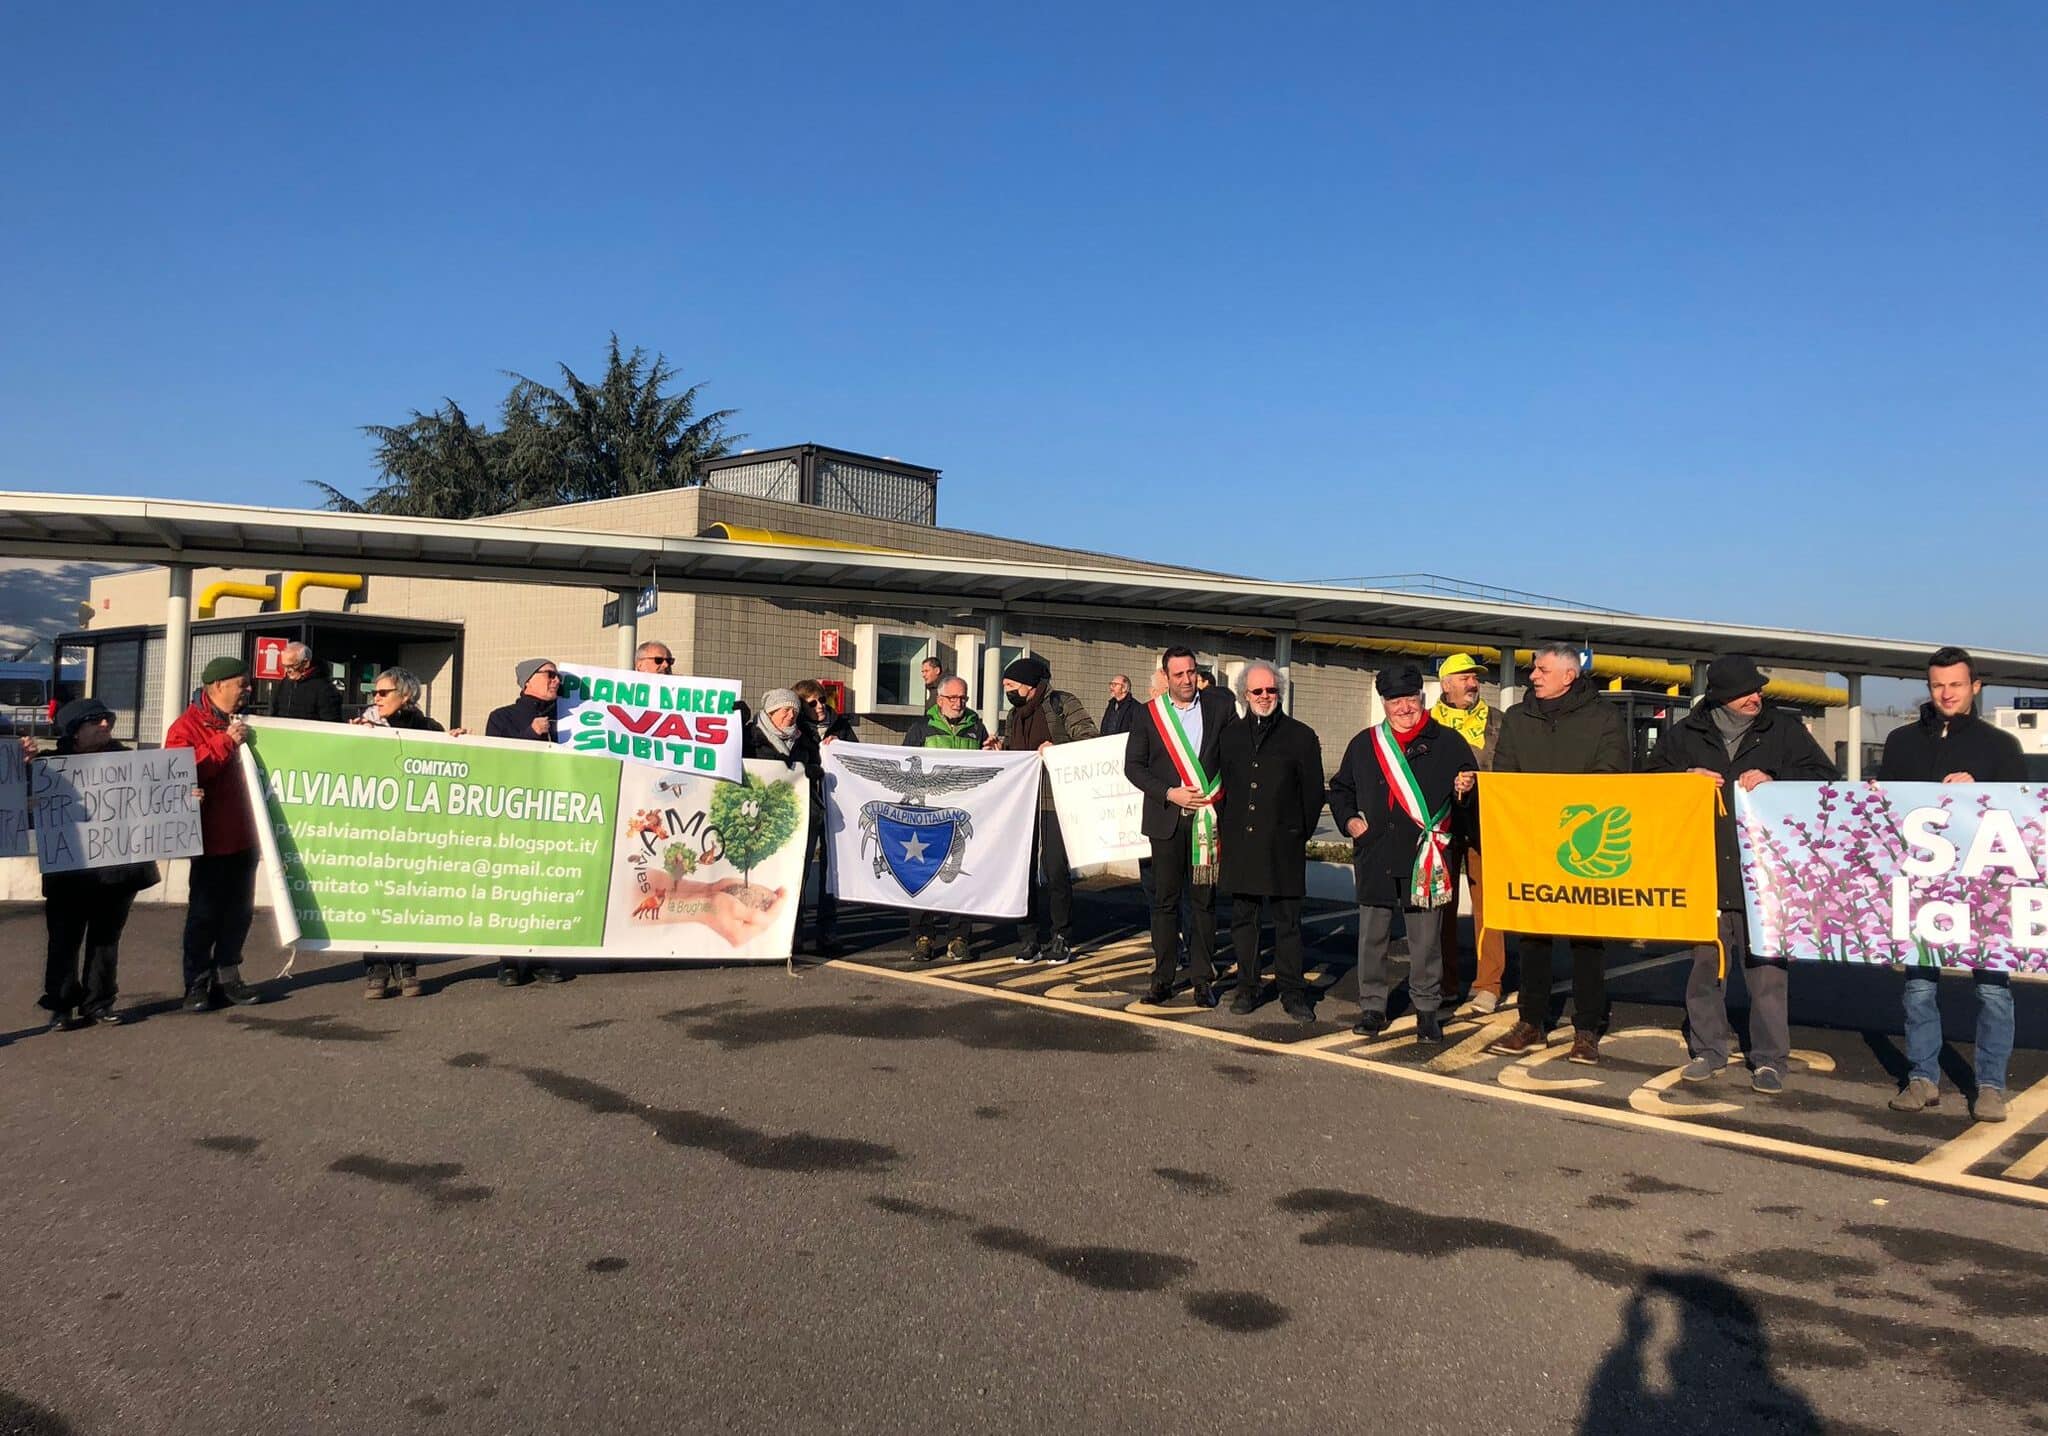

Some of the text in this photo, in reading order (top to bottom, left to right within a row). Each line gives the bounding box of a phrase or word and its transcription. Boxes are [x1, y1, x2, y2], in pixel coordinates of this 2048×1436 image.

[563, 676, 650, 708] PIANO
[579, 704, 729, 745] e VAS
[573, 729, 717, 771] SUBITO
[71, 762, 132, 788] MILIONI
[142, 761, 161, 781] AL
[403, 758, 469, 779] COMITATO
[38, 782, 199, 829] PER DISTRUGGERE
[263, 768, 605, 825] ALVIAMO LA BRUGHIERA
[864, 803, 967, 825] CLUB ALPINO ITALIANO
[44, 818, 201, 864] LA BRUGHIERA
[276, 820, 599, 856] p://salviamolabrughiera.blogspot.it/
[1902, 807, 2048, 880] SA
[472, 884, 486, 900] la
[1507, 882, 1687, 908] LEGAMBIENTE
[1892, 876, 1971, 944] la
[295, 905, 366, 923] omitato
[468, 911, 483, 927] la
